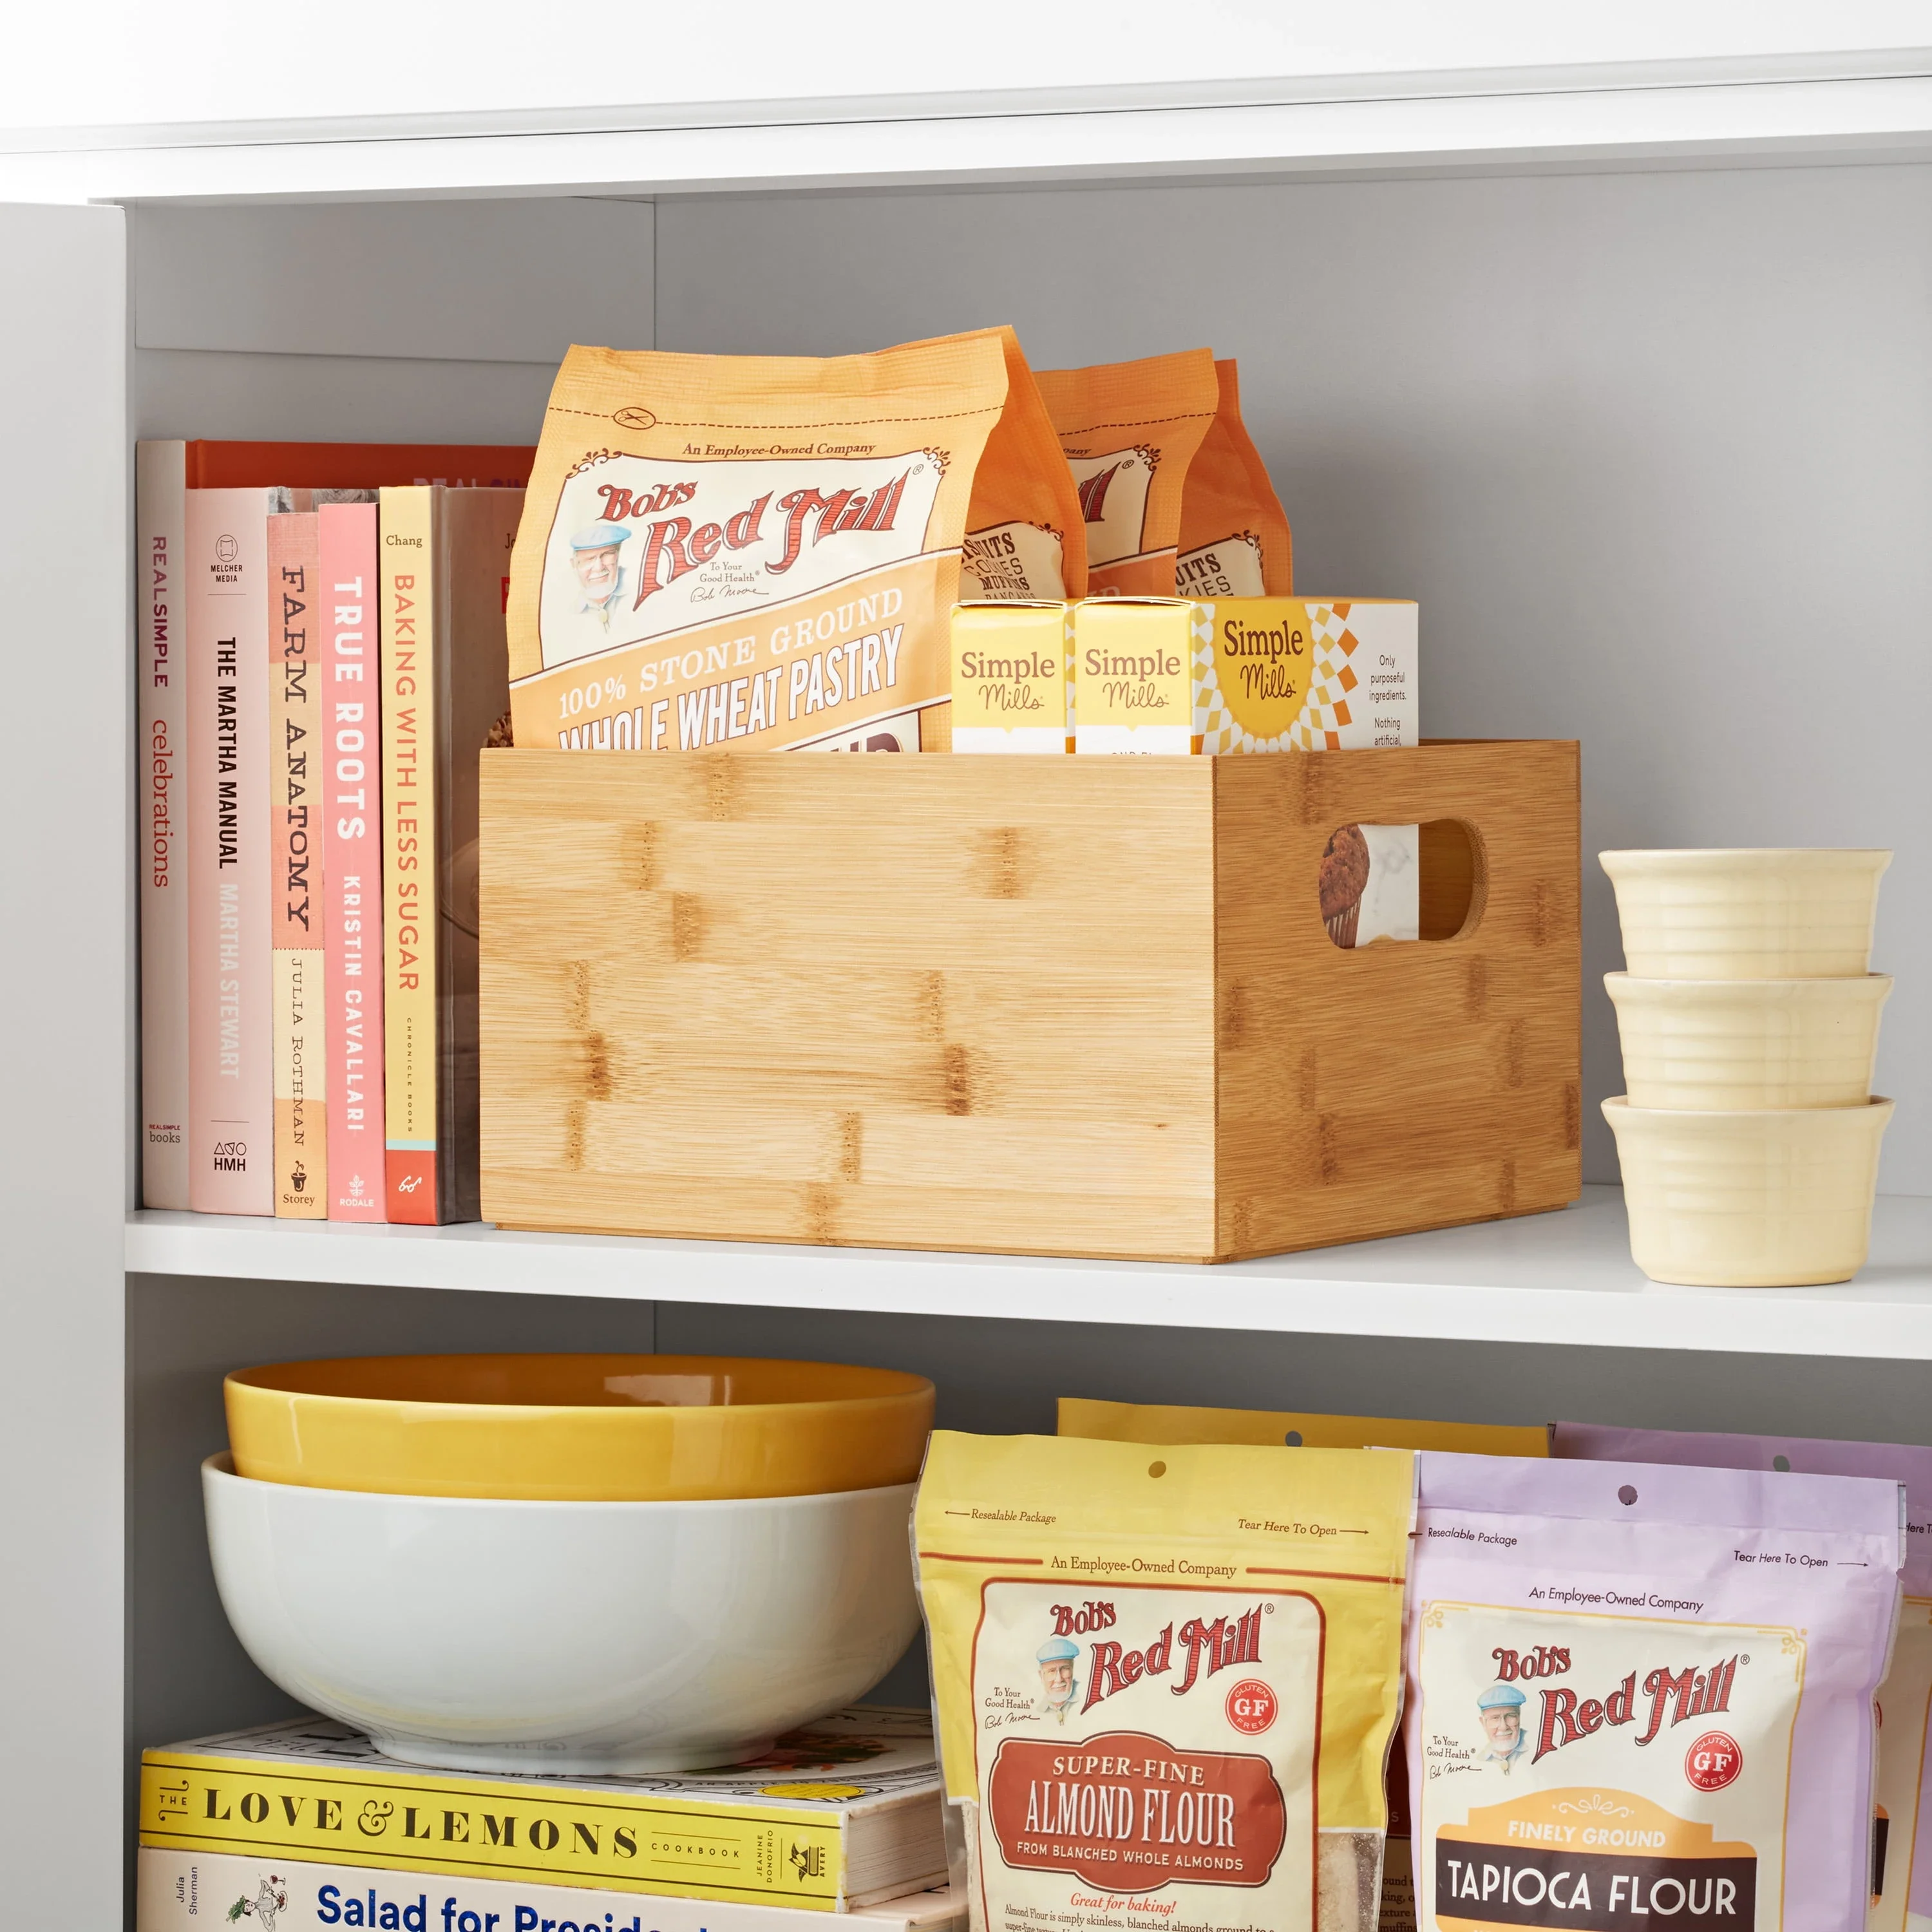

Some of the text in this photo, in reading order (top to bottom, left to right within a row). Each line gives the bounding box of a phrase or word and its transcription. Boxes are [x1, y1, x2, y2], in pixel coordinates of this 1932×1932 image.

[683, 443, 876, 457] An Employee-Owned Company
[386, 535, 422, 547] Chang
[596, 467, 909, 612] Bob's Red Mill
[211, 564, 243, 573] MELCHER
[699, 573, 723, 582] Good
[710, 562, 742, 571] To Your
[558, 587, 902, 719] 100% STONE GROUND
[1224, 620, 1303, 663] Simple
[961, 651, 1055, 684] Simple
[1085, 649, 1180, 682] Simple
[1379, 654, 1396, 668] Only
[558, 623, 905, 750] OLE WHEAT PASTRY
[1240, 664, 1296, 701] Mills
[1371, 672, 1405, 687] purposeful
[979, 683, 1045, 711] Mills
[1103, 681, 1170, 708] Mills
[1369, 690, 1406, 703] ingredients.
[334, 576, 365, 840] TRUE ROOTS
[1374, 717, 1401, 731] Nothing
[218, 637, 238, 869] THE MARTHA MANUAL
[282, 565, 309, 932] FARM ANATOMY
[394, 575, 419, 990] BAKING WITH LESS SUGAR
[152, 719, 173, 888] celebrations
[220, 883, 240, 1079] MARTHA STEWART
[343, 875, 365, 1131] KRISTIN CAVALLARI
[292, 958, 305, 1146] JULIA ROTHMAN
[149, 1131, 180, 1143] books
[214, 1157, 245, 1171] HMH
[283, 1194, 315, 1206] Storey
[339, 1198, 374, 1207] RODALE
[971, 1508, 1057, 1525] Resealable Package
[1238, 1519, 1337, 1537] Tear Here To Open
[1428, 1528, 1517, 1548] Resealable Package
[1051, 1556, 1237, 1579] An Employee-Owned Company
[1734, 1550, 1828, 1568] Tear Here To Open
[1529, 1587, 1704, 1614] An Employee-Owned Company
[1050, 1601, 1263, 1716] Bob's Red Mill
[985, 1698, 1005, 1708] Good
[994, 1687, 1021, 1697] To Your
[1235, 1685, 1269, 1699] GLUTEN
[1234, 1698, 1269, 1716] GF
[1492, 1645, 1738, 1765] Bob's Red Mill
[1236, 1718, 1265, 1729] FREE
[1426, 1747, 1443, 1757] Good
[1433, 1736, 1459, 1747] To Your
[1696, 1737, 1732, 1752] GLUTEN
[1053, 1756, 1205, 1787] SUPER-FINE
[1694, 1752, 1732, 1772] GF
[1694, 1772, 1727, 1785] FREE
[159, 1788, 639, 1859] THE LOVE & LEMONS
[1024, 1780, 1236, 1848] ALMOND FLOUR
[1508, 1820, 1667, 1848] FINELY GROUND
[652, 1842, 739, 1858] COOKBOOK
[1017, 1841, 1244, 1871] FROM BLANCHED WHOLE ALMONDS
[176, 1877, 185, 1903] Julia
[189, 1867, 197, 1915] Sherman
[1447, 1859, 1737, 1916] TAPIOCA FLOUR
[317, 1884, 426, 1932] Salad
[441, 1897, 500, 1932] for
[1070, 1892, 1177, 1917] Great for baking!
[1379, 1908, 1410, 1917] exture
[1005, 1904, 1028, 1918] Almond
[1030, 1908, 1048, 1920] Flour
[1050, 1911, 1056, 1921] is
[1057, 1911, 1085, 1927] simply
[1086, 1914, 1125, 1928] skinless,
[1127, 1917, 1169, 1931] blanched
[1172, 1921, 1213, 1932] almonds
